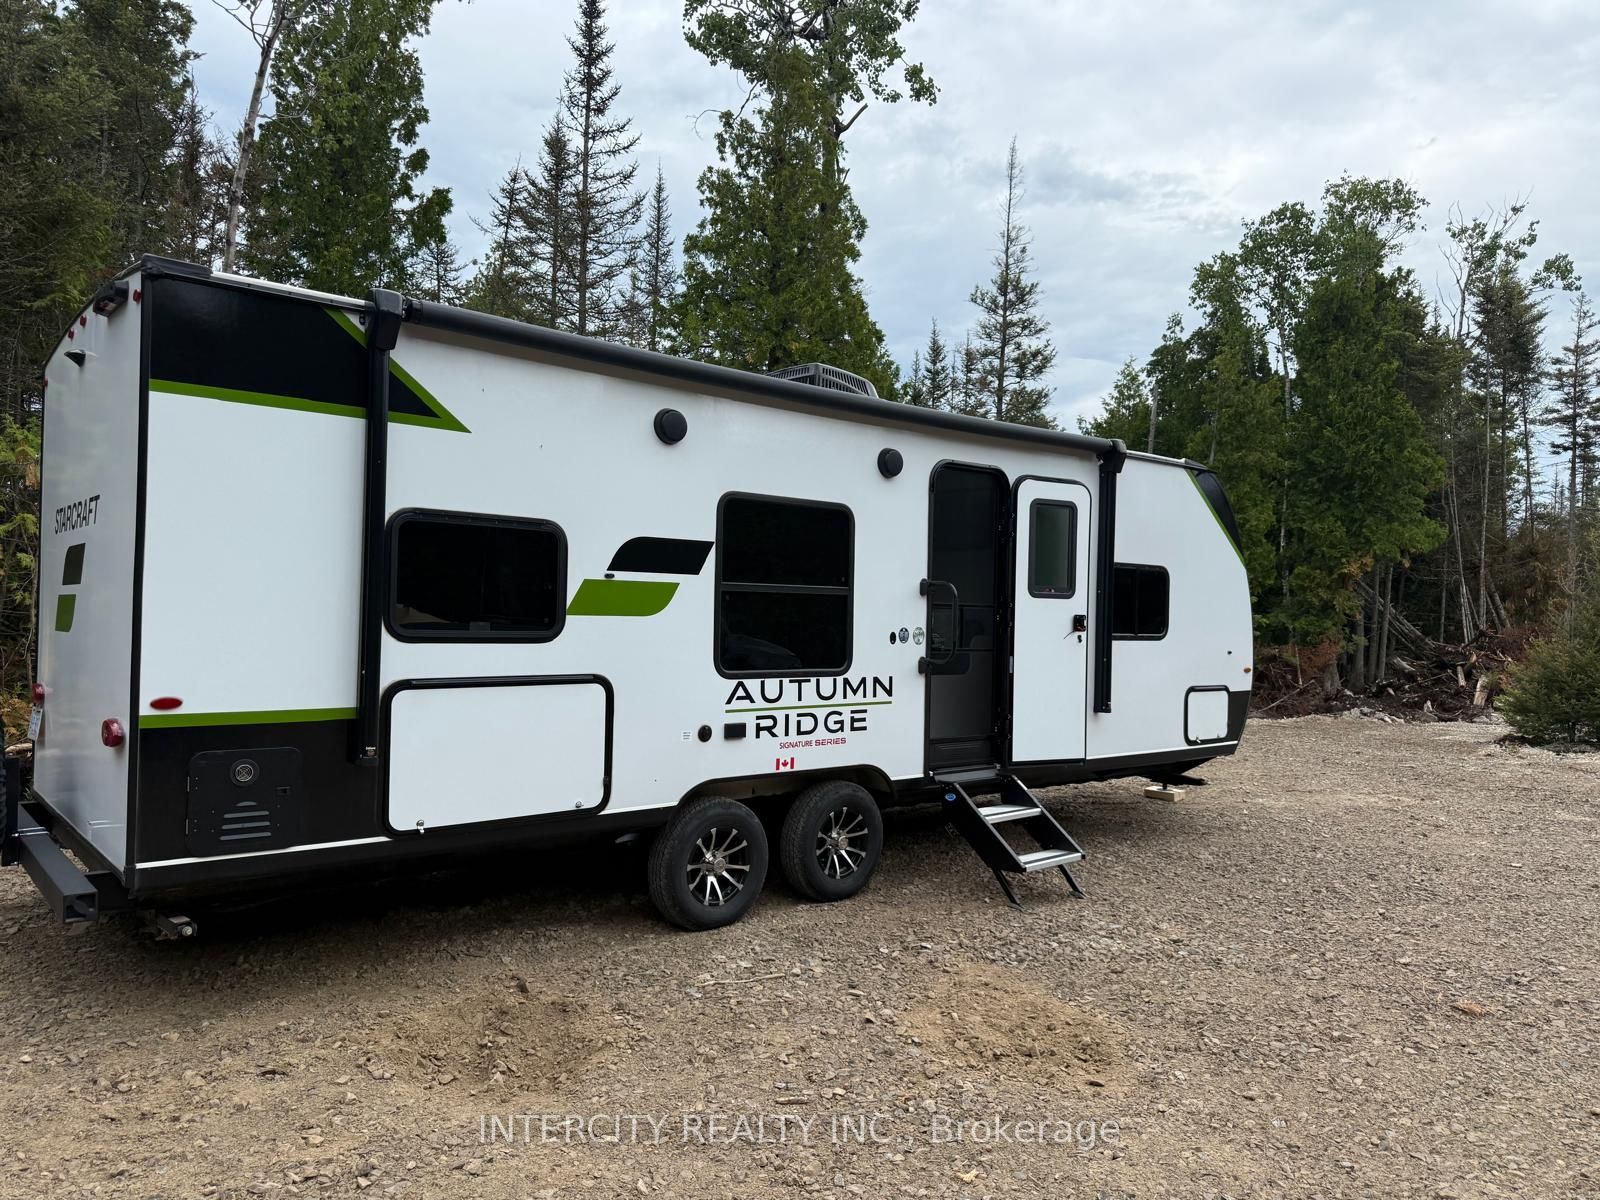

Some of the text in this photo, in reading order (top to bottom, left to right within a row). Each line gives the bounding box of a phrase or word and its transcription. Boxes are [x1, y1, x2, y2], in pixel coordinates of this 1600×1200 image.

[55, 494, 100, 534] STARCRAFT
[725, 676, 893, 705] AUTUMN
[755, 709, 868, 739] RIDGE
[779, 737, 847, 750] SIGNATURE SERIES
